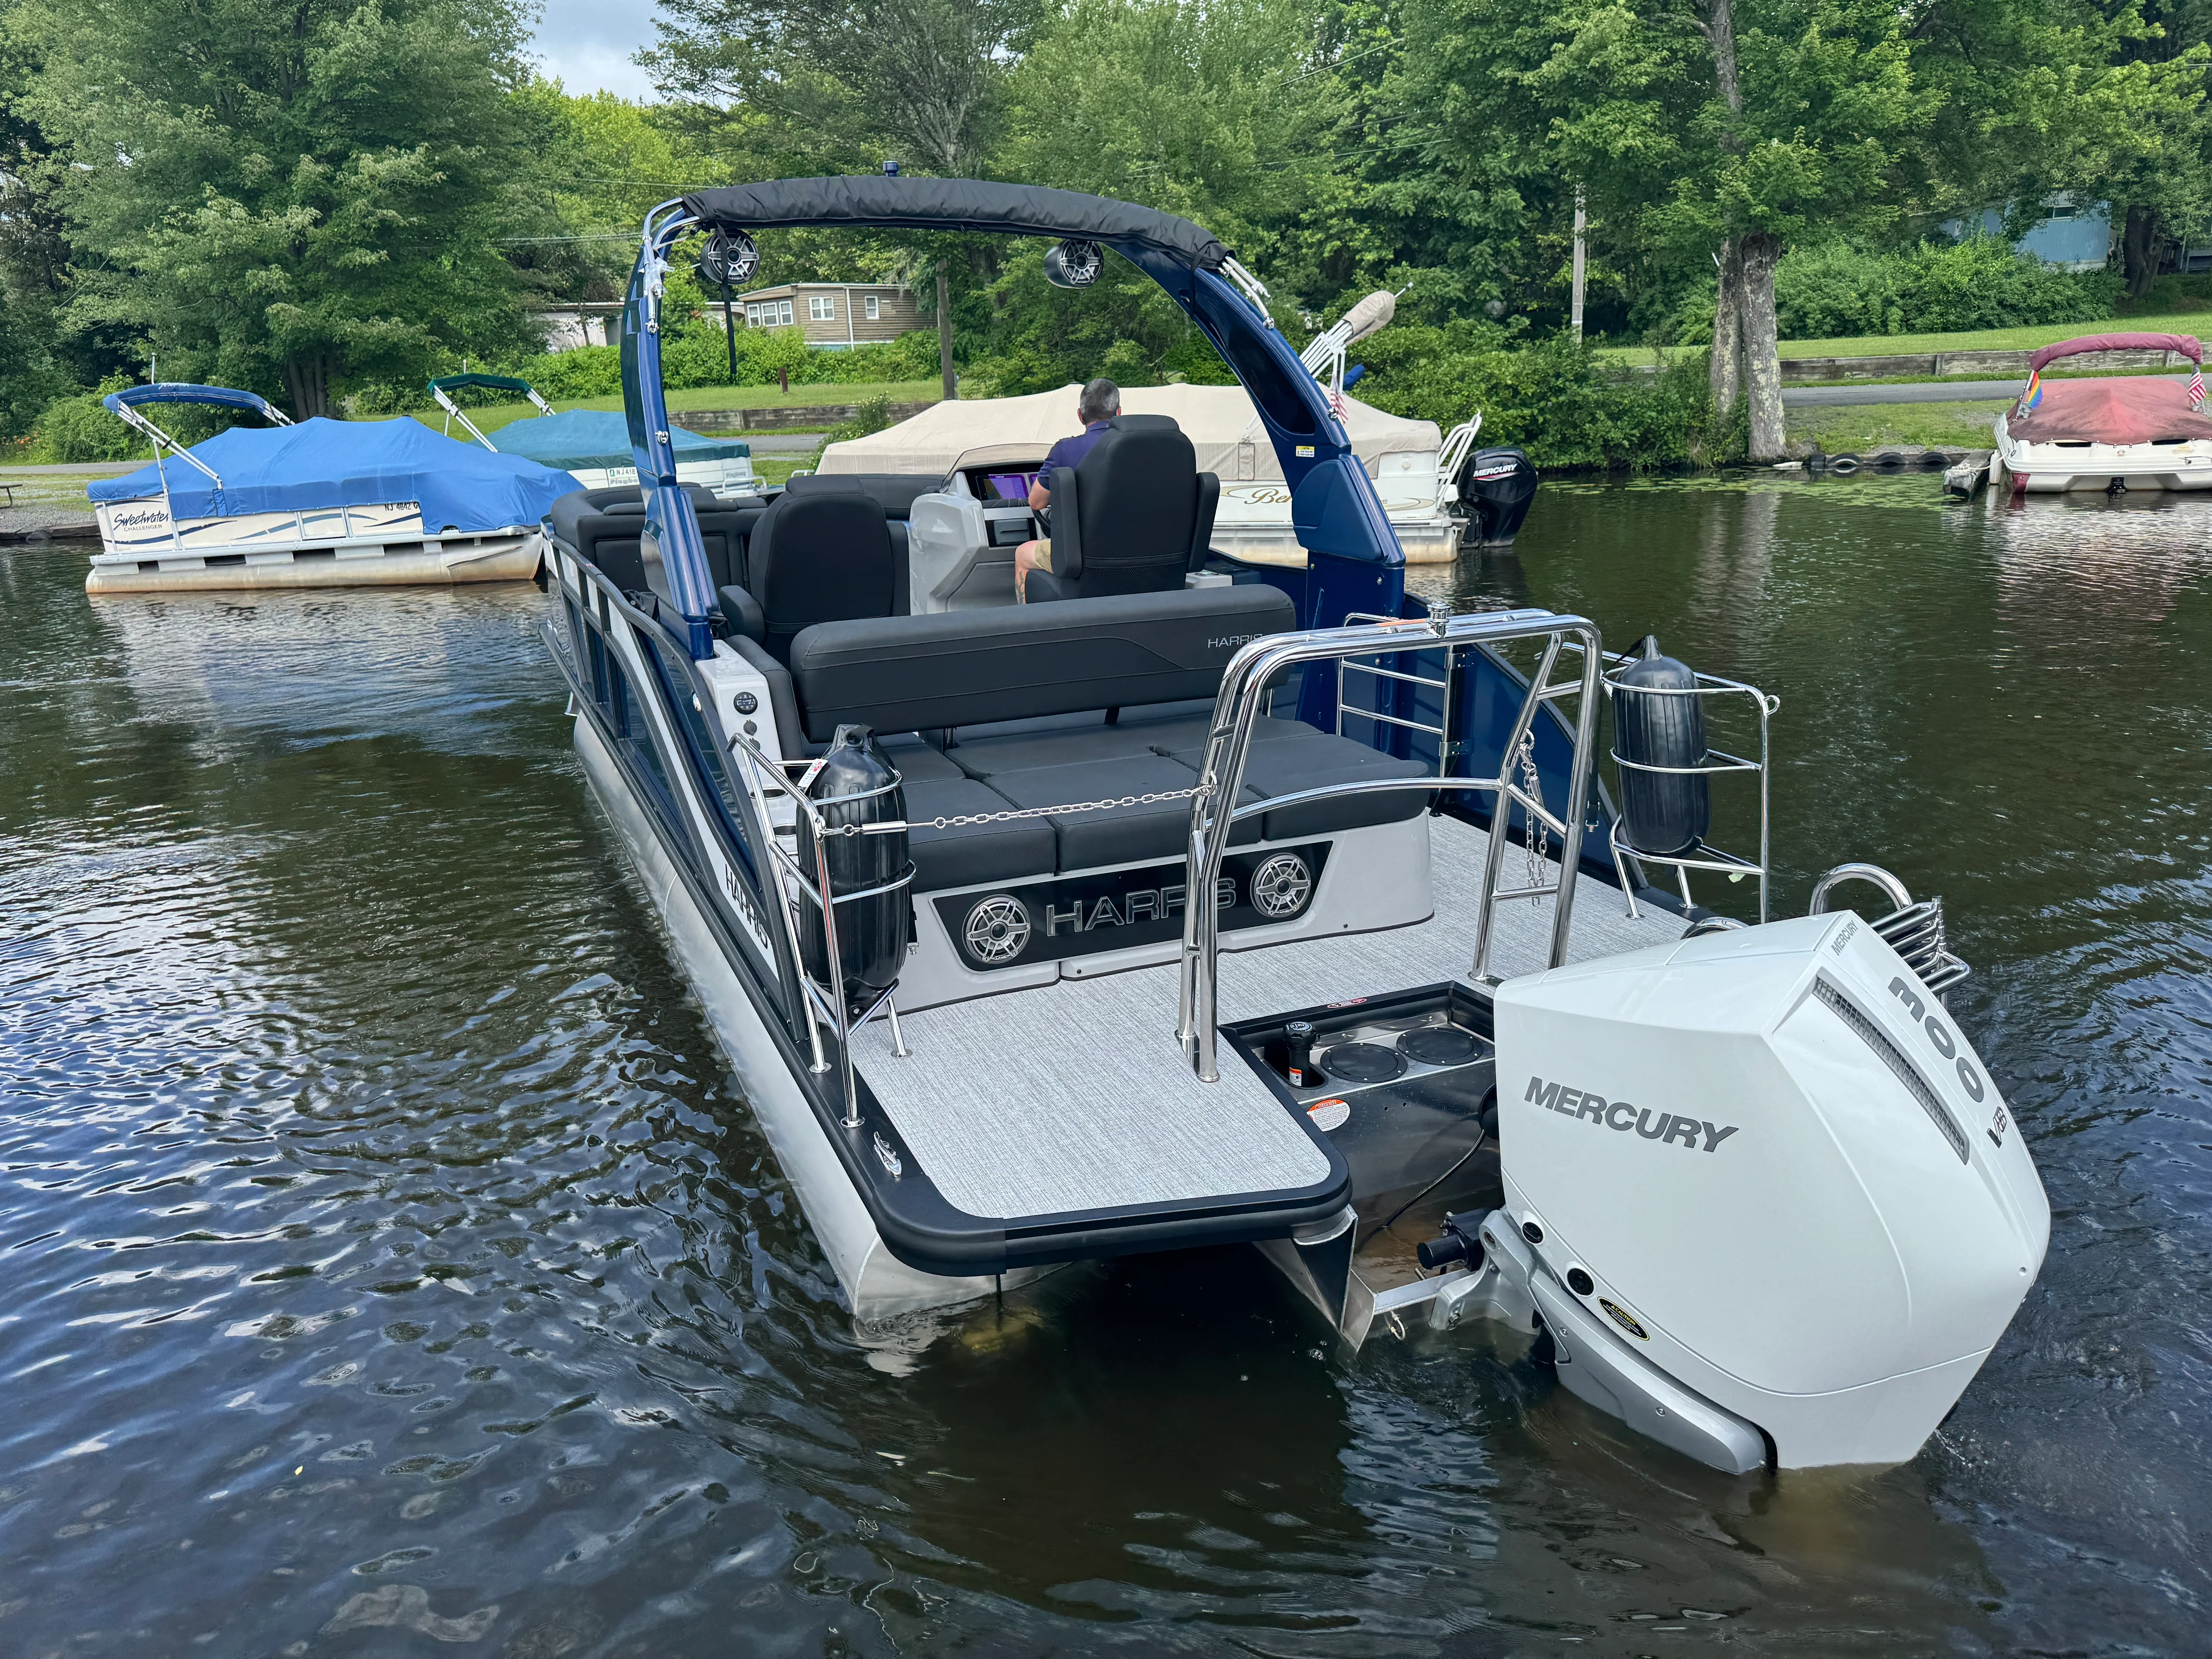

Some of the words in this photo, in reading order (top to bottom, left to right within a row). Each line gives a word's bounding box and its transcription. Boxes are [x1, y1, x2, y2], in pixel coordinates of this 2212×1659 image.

[1473, 463, 1518, 478] MERCURY
[113, 510, 169, 530] Sweetwater
[1046, 877, 1237, 937] HARRS
[1831, 920, 1859, 956] MERCURY
[1524, 1076, 1739, 1153] MERCURY
[1986, 1106, 2007, 1149] V8
[1615, 1308, 1636, 1325] CAUTION
